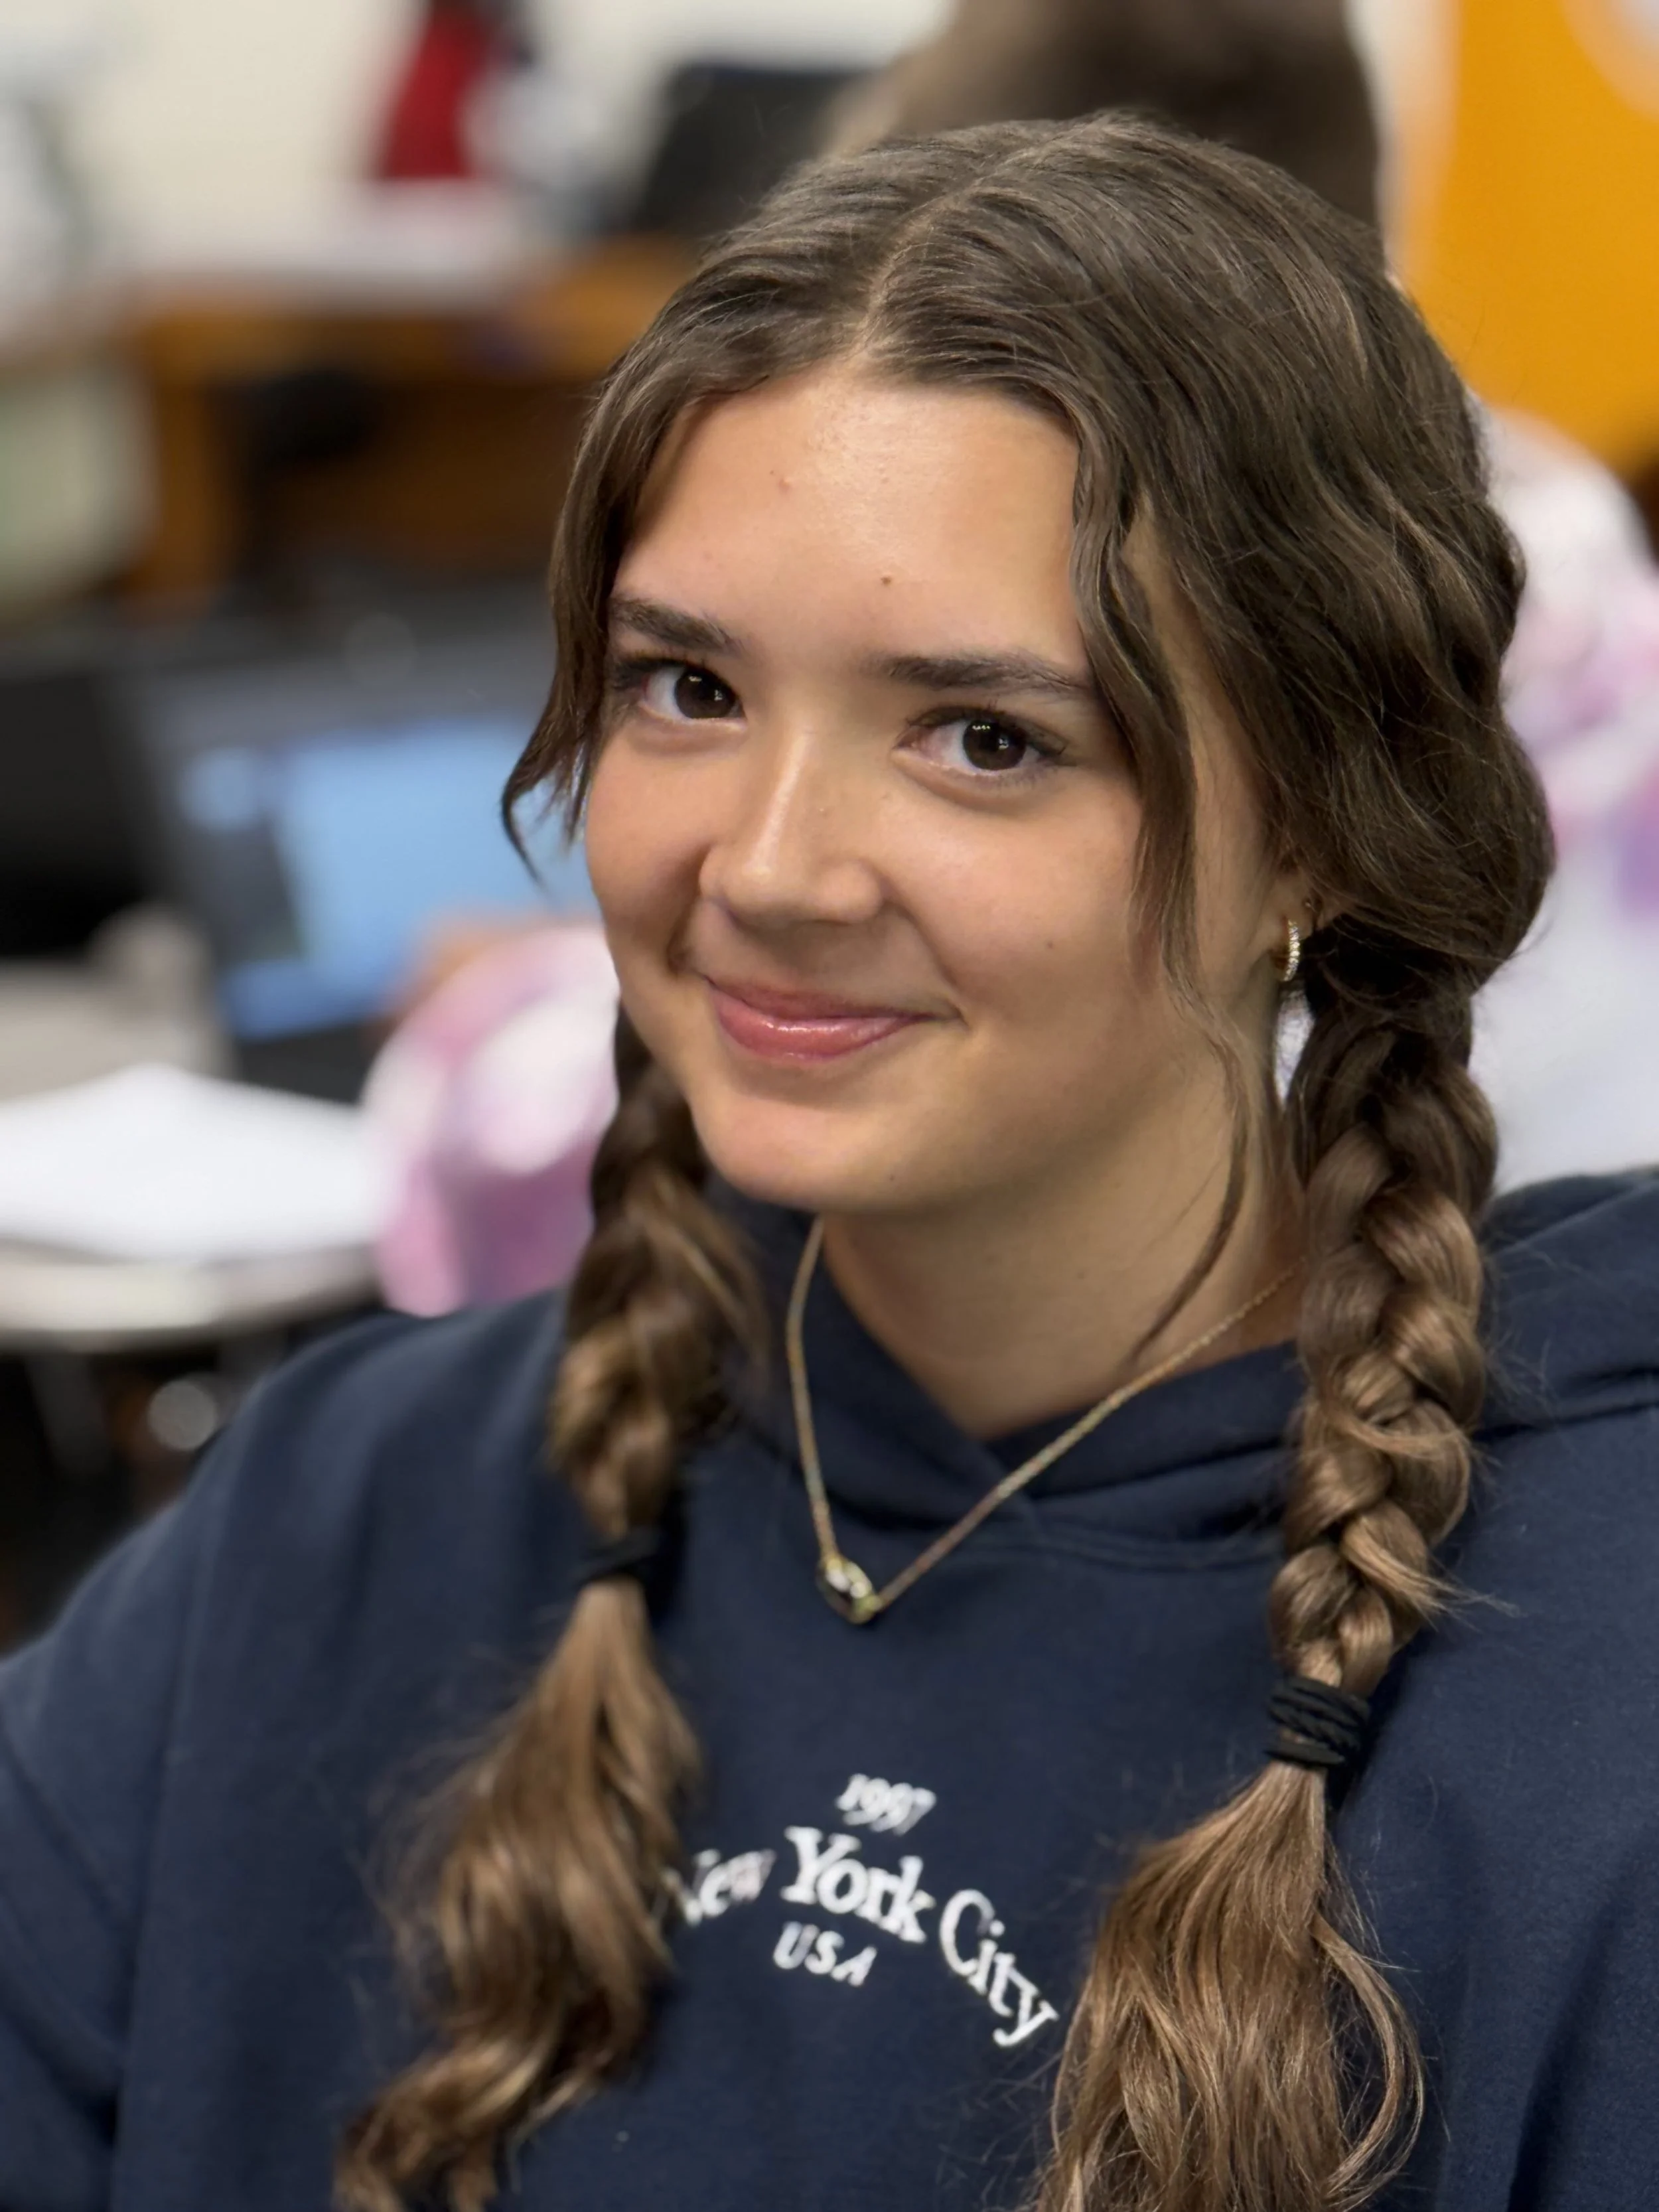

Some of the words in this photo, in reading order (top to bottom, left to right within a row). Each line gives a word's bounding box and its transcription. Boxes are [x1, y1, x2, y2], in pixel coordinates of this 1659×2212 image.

[772, 1921, 878, 1987] USA
[780, 1825, 936, 1944] York
[939, 1888, 1060, 2047] City
